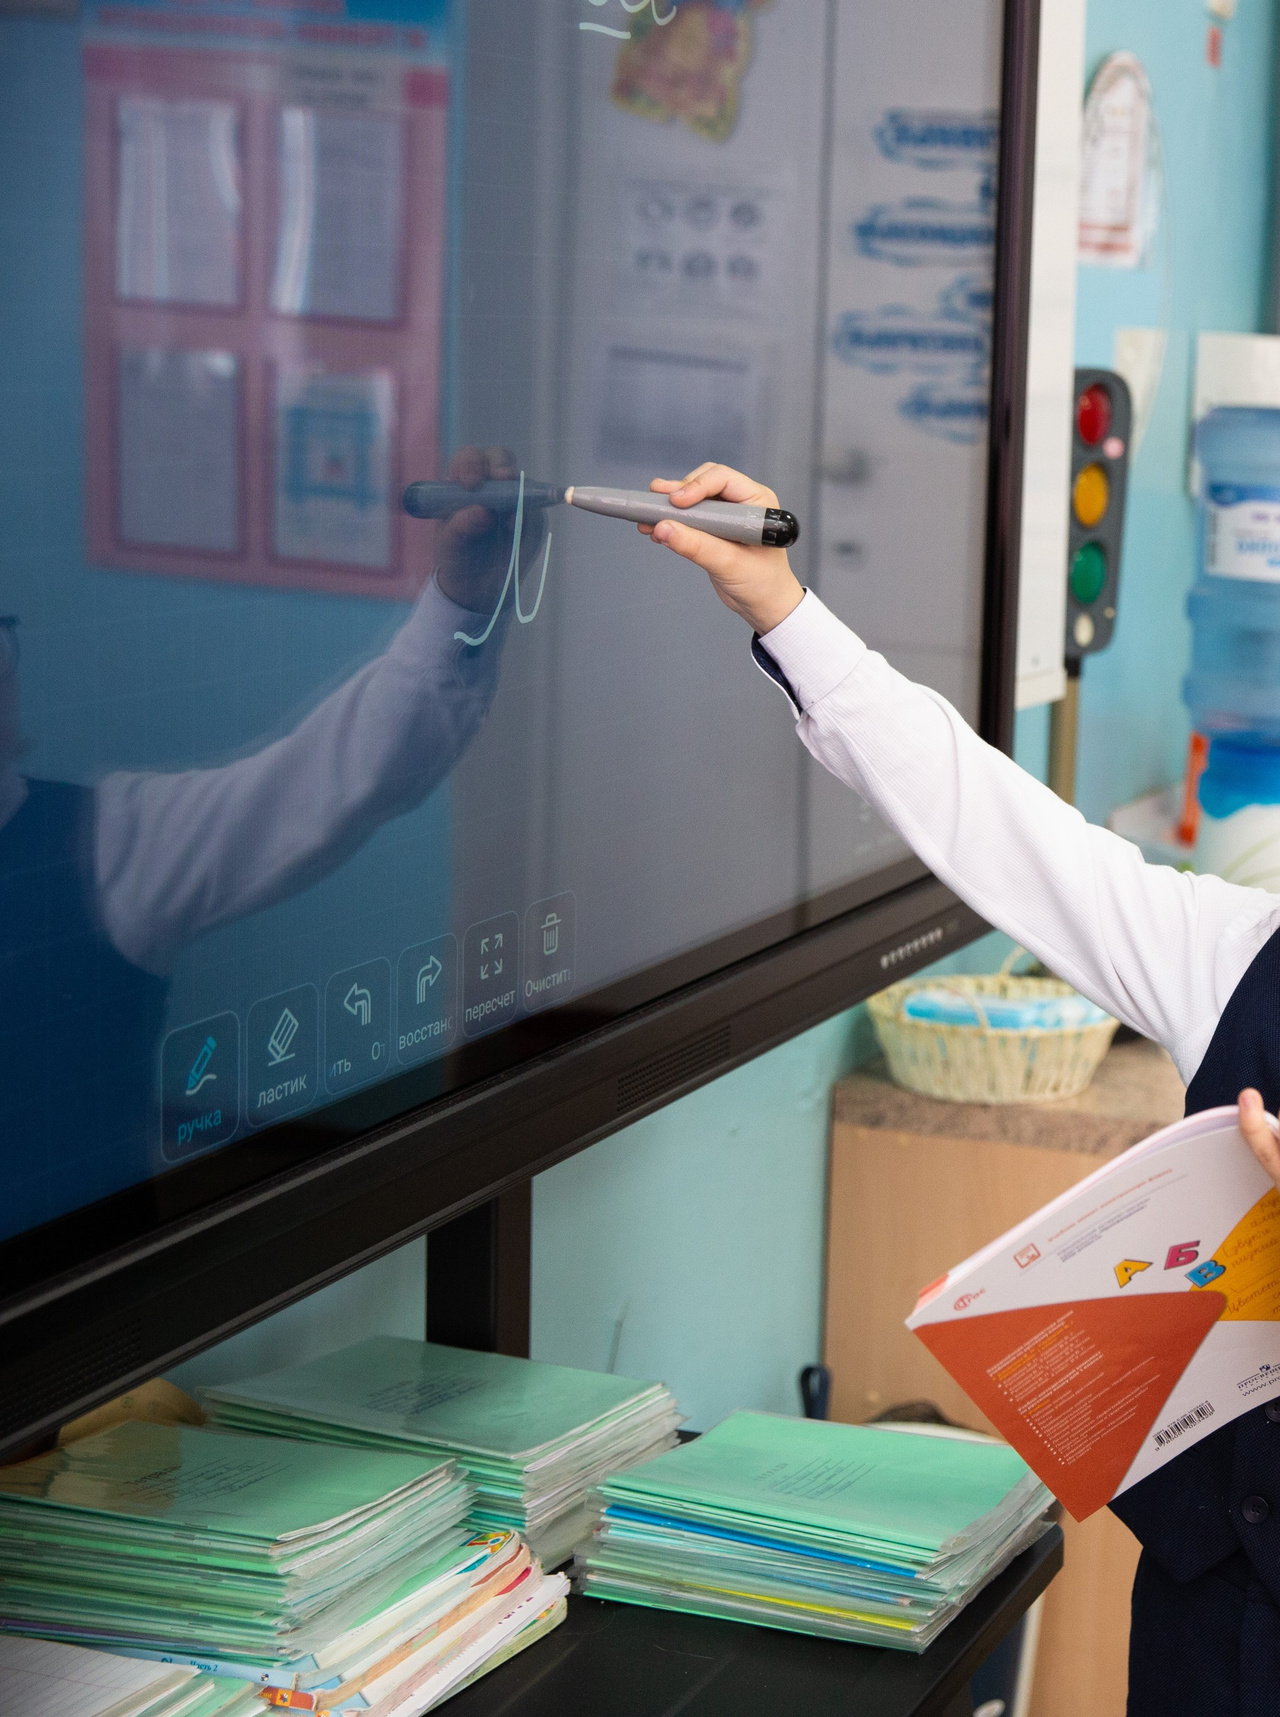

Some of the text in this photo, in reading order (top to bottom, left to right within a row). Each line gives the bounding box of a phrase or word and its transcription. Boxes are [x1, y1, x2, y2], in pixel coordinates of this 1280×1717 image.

[525, 968, 571, 998] Очистит
[465, 990, 516, 1022] пересчет
[257, 1073, 307, 1108] ластик
[177, 1108, 222, 1146] ручка
[1164, 1239, 1201, 1270] Б
[1113, 1258, 1154, 1288] А
[1184, 1259, 1226, 1288] В
